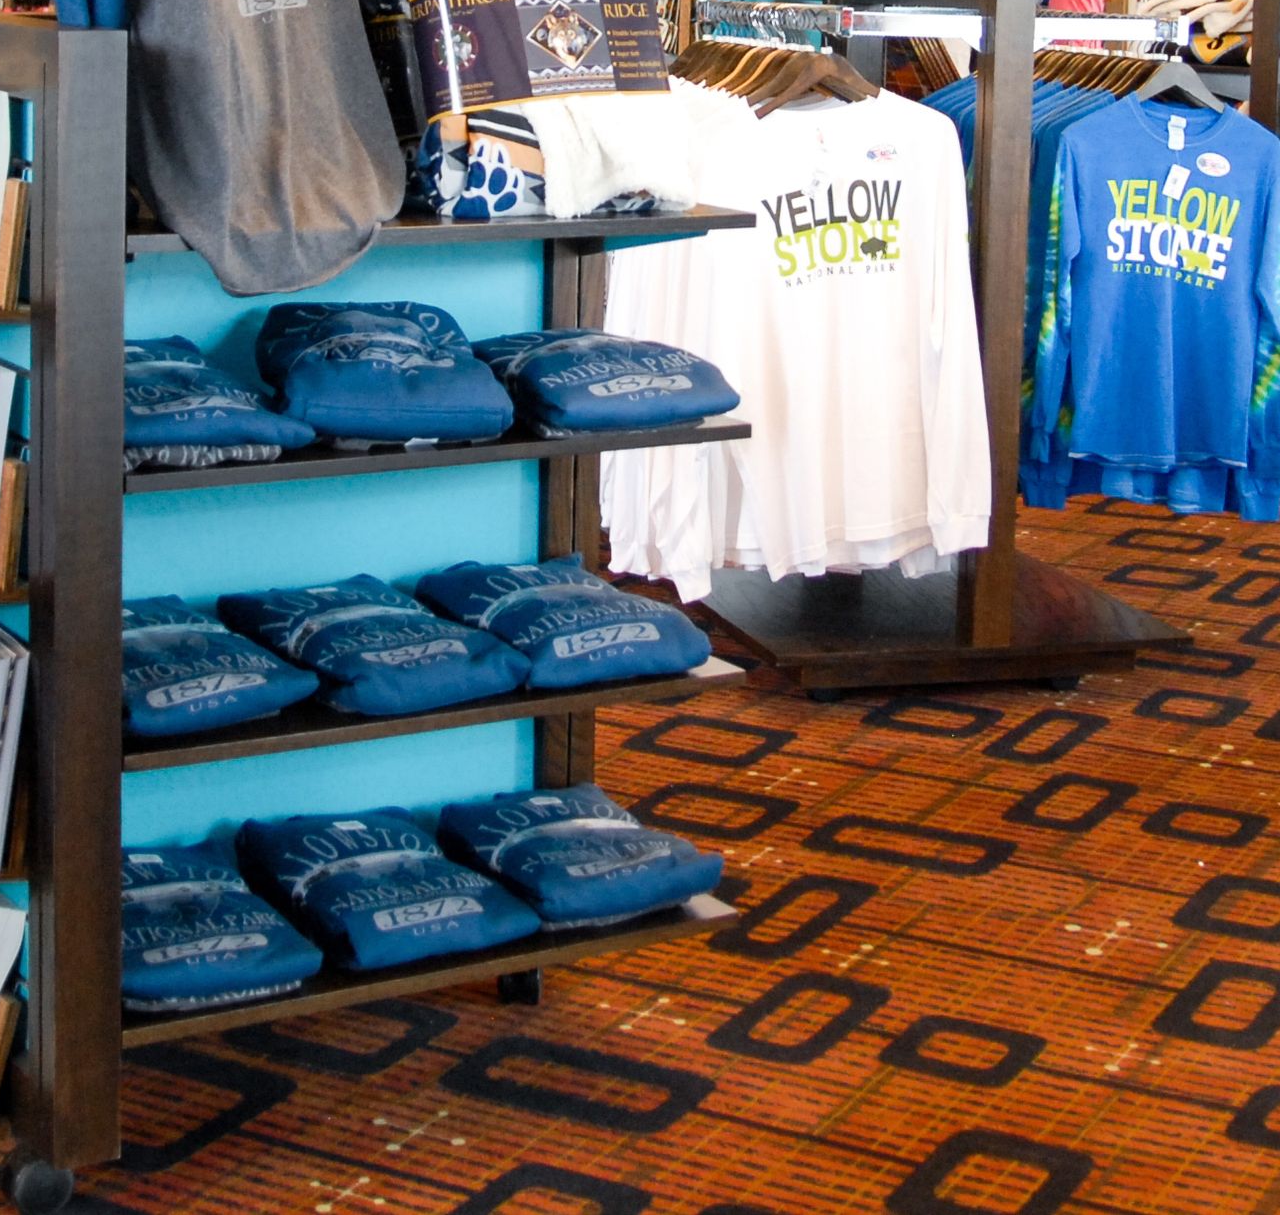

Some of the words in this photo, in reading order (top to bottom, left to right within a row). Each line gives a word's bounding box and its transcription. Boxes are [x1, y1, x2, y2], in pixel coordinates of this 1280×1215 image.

[603, 2, 650, 19] RIDGE
[761, 179, 902, 238] YELLOW
[1107, 180, 1241, 237] YELLOW
[773, 219, 901, 277] STONE
[1106, 218, 1233, 280] STONE
[1175, 272, 1216, 290] PARK
[628, 389, 672, 402] USA
[175, 408, 228, 422] USA
[562, 624, 647, 655] 1872
[588, 645, 635, 662] USA
[122, 656, 215, 686] ATIONAL
[189, 694, 238, 714] USA
[384, 897, 475, 926] 1872
[413, 921, 460, 936] USA
